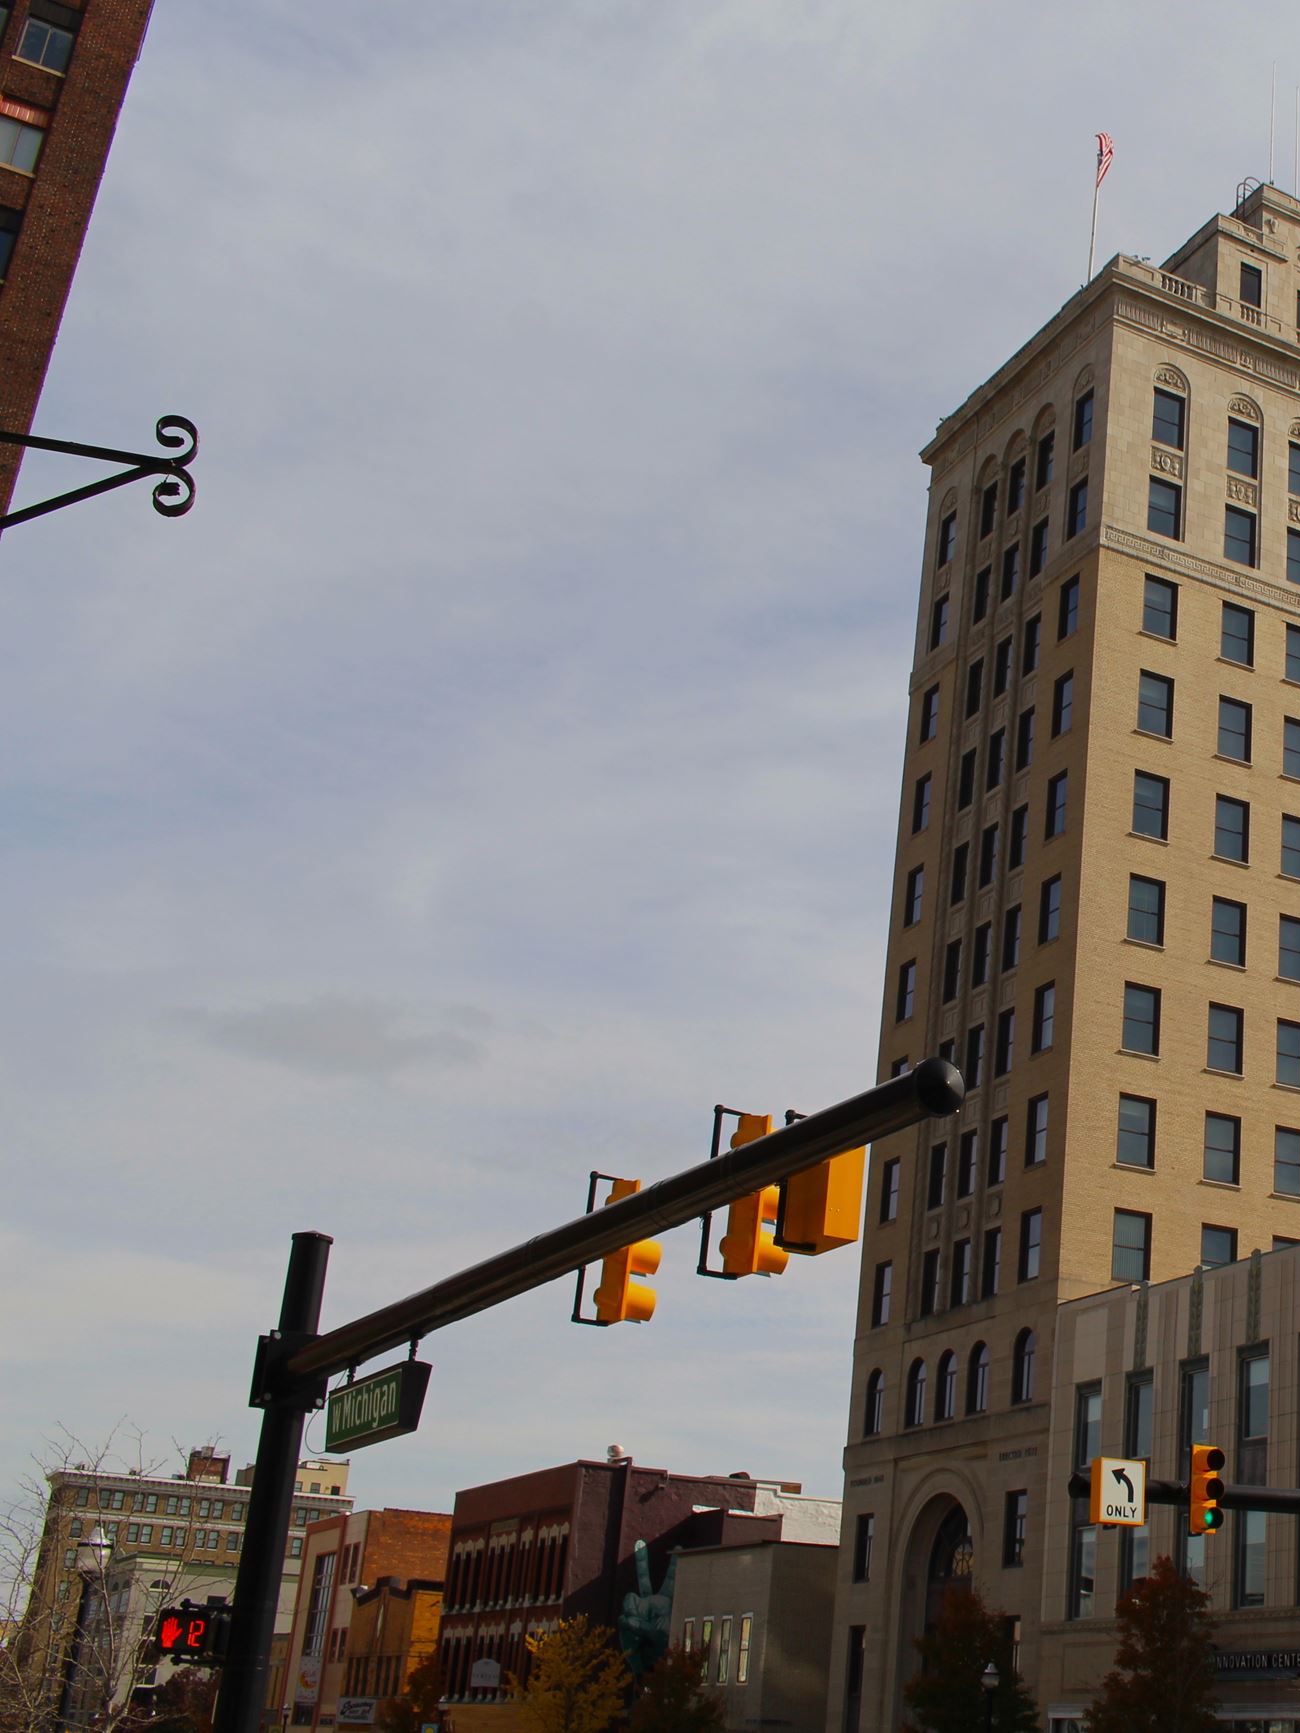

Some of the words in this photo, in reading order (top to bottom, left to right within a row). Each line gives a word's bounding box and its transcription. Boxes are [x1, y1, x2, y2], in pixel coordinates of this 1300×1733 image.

[332, 1402, 341, 1433] W
[342, 1381, 396, 1428] Michigan
[1106, 1504, 1137, 1518] ONLY
[187, 1620, 205, 1647] 12
